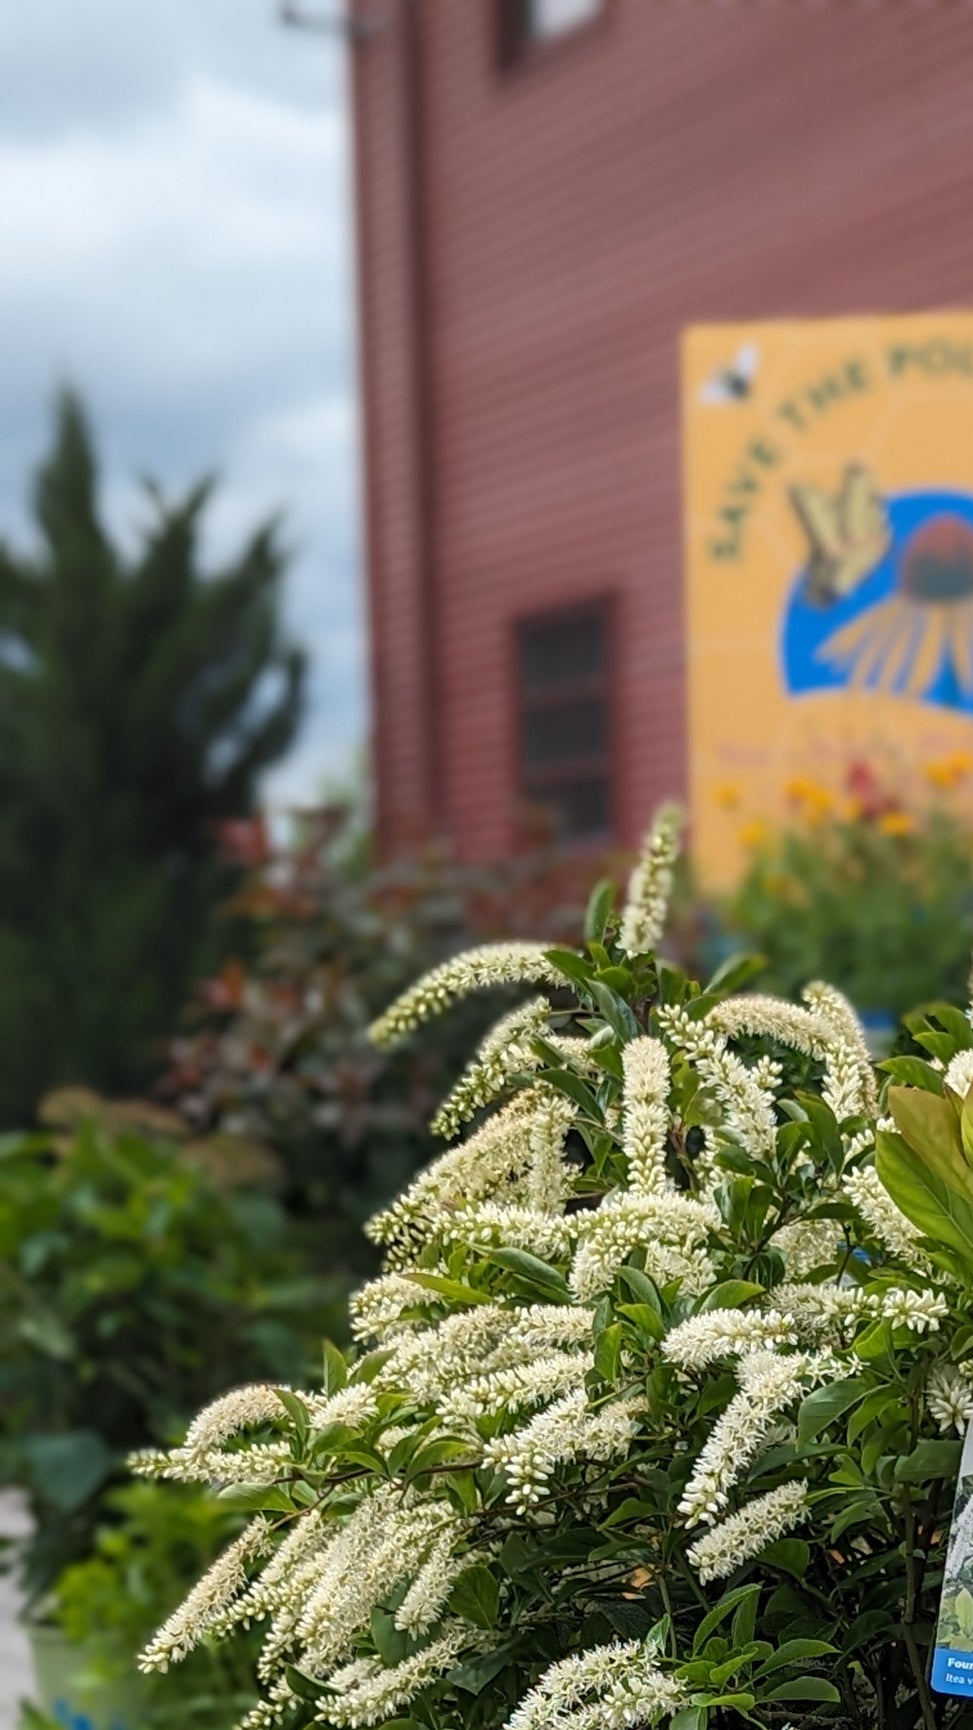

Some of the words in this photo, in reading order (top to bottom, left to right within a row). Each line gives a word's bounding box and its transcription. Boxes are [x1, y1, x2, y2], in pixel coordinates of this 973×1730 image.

[710, 437, 780, 563] SAVE
[778, 360, 868, 432] THE
[945, 1673, 966, 1686] Itea
